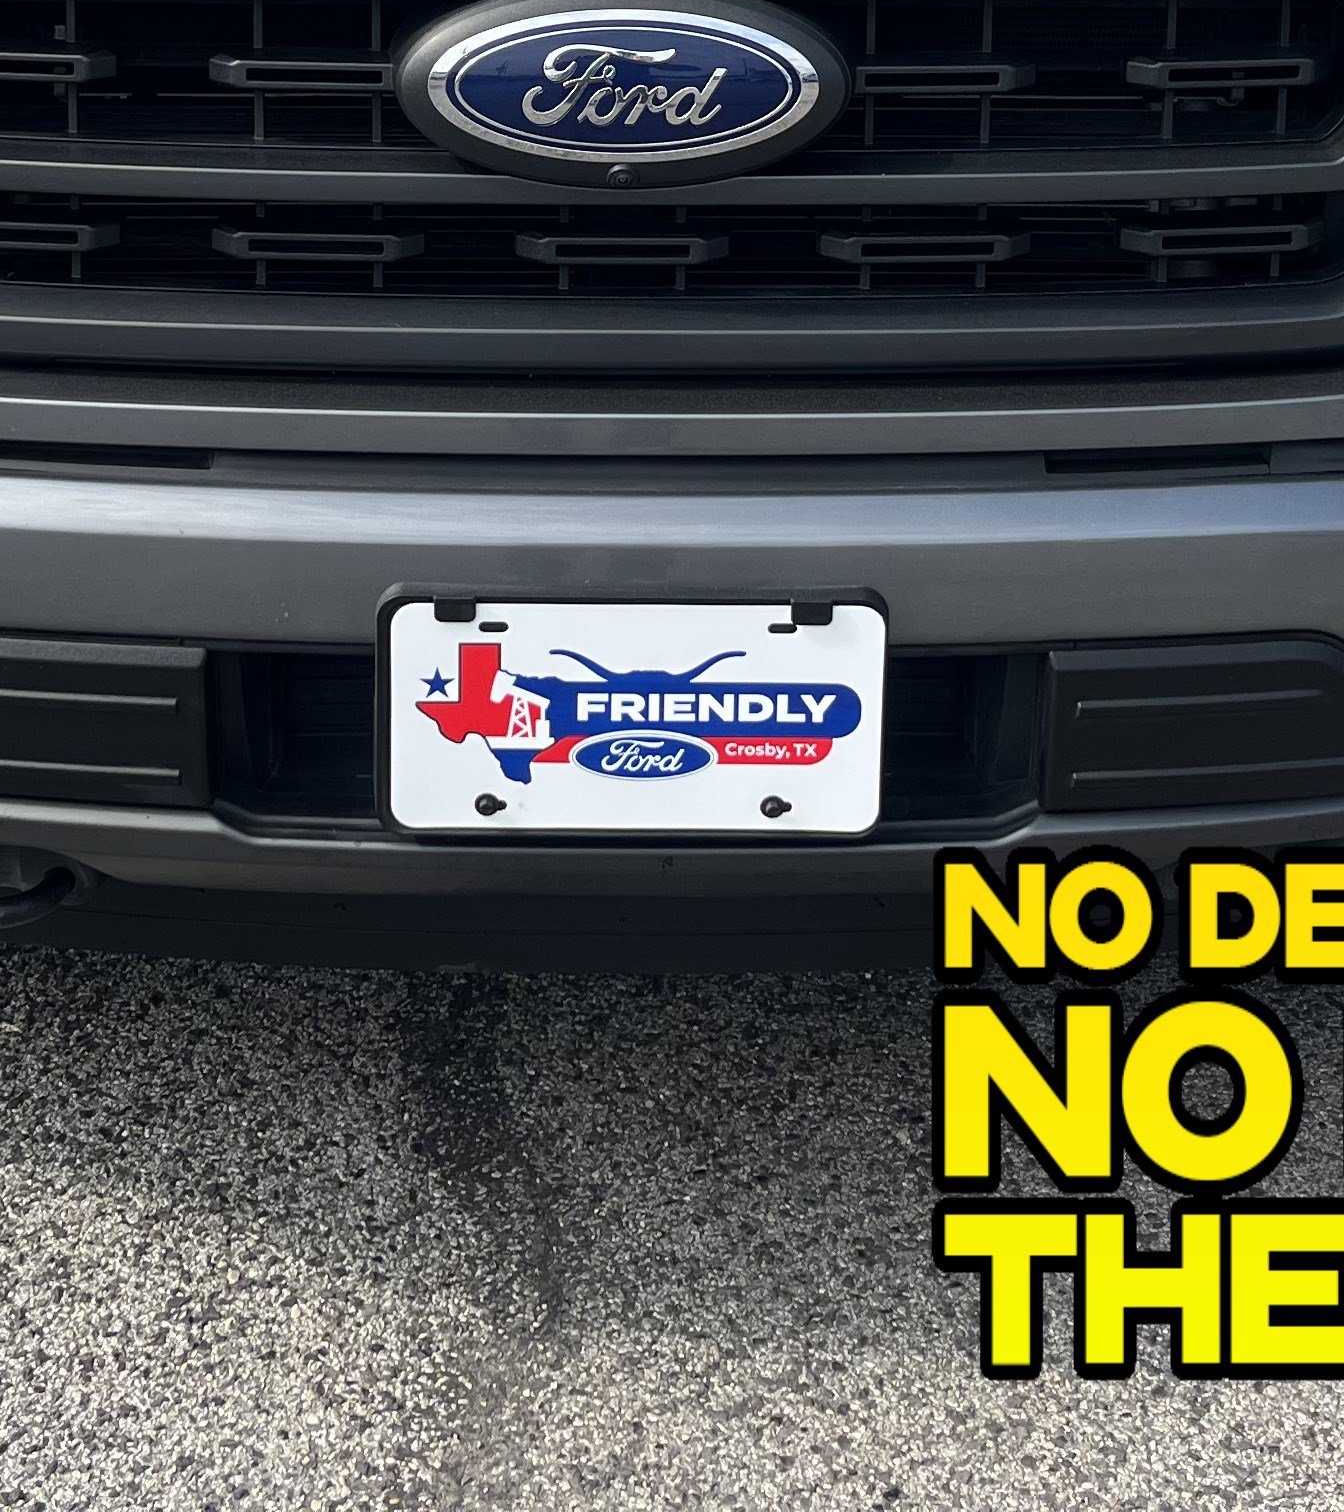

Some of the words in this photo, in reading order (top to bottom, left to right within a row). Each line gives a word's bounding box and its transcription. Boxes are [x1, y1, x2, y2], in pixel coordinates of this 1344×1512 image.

[521, 43, 729, 127] Ford
[577, 693, 837, 724] FRIENDLY
[600, 739, 685, 774] Ford
[724, 741, 791, 759] Crosby,
[793, 743, 818, 758] TX
